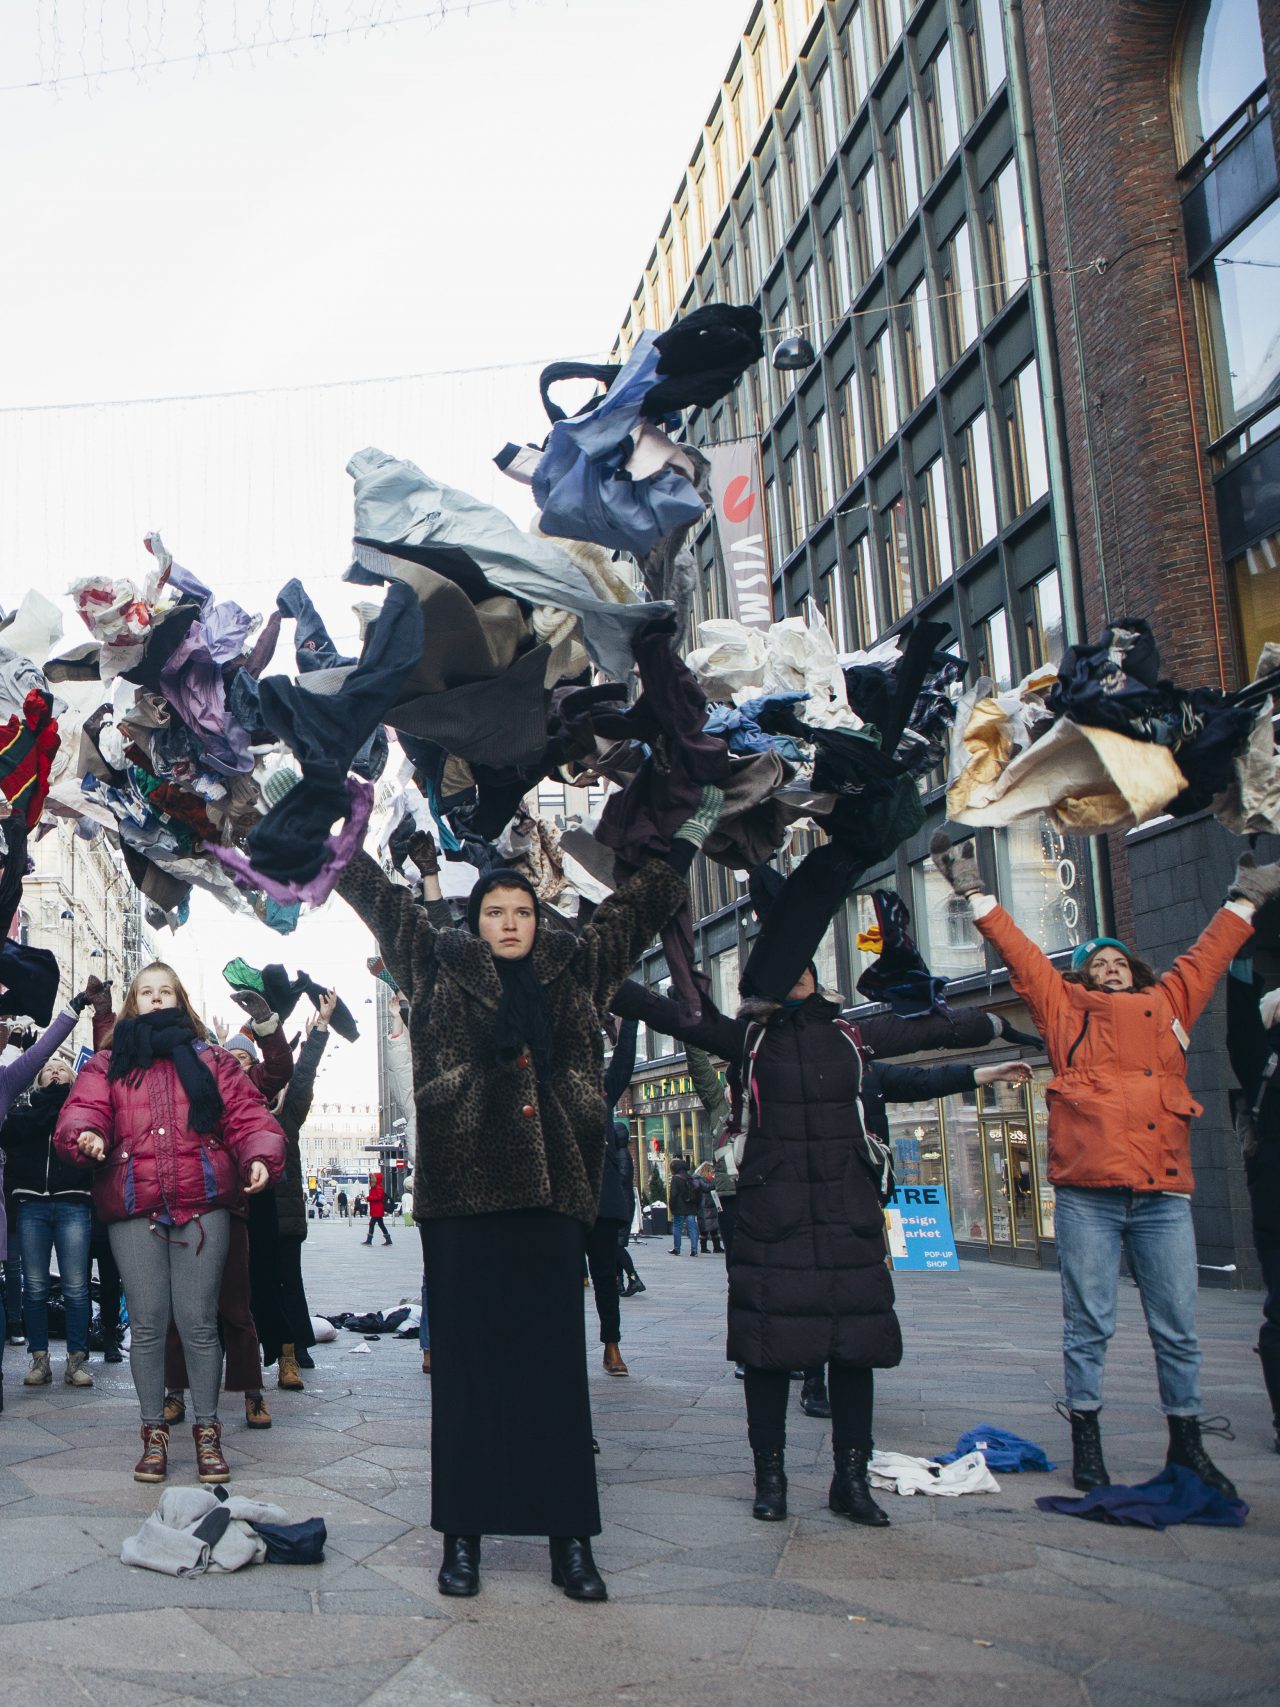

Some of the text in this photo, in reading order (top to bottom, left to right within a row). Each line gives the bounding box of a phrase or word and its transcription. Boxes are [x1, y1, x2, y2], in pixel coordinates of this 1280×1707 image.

[642, 1083, 656, 1100] LA
[893, 1215, 937, 1226] esign
[896, 1229, 942, 1238] arket
